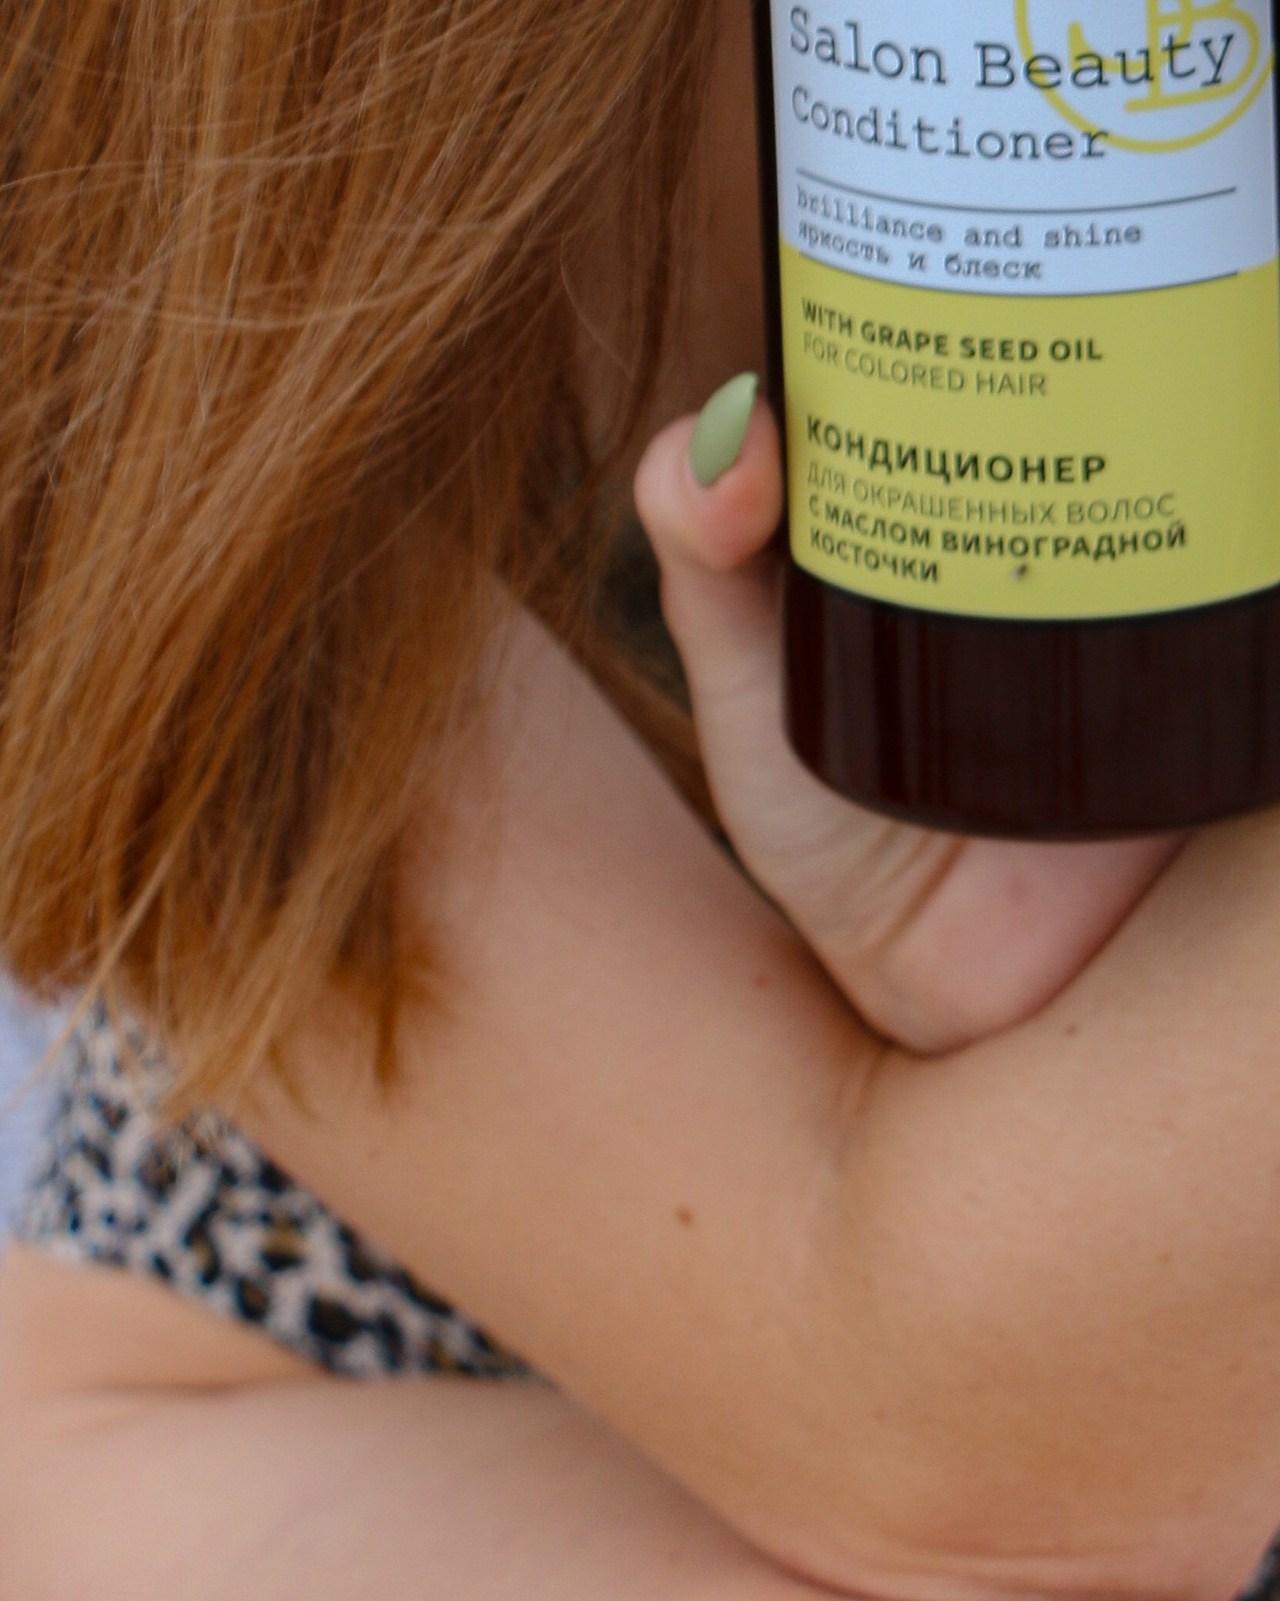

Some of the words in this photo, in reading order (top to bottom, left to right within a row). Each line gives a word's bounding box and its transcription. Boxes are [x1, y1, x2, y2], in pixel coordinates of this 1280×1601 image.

[790, 7, 946, 85] Salon
[974, 33, 1234, 88] Beauty
[791, 85, 1107, 159] Conditioner
[799, 220, 890, 265] яркость
[908, 252, 927, 271] и
[945, 253, 1043, 280] блеск
[964, 226, 1023, 248] and
[1044, 224, 1142, 248] shine
[802, 299, 853, 337] WITH
[860, 320, 949, 355] GRAPE
[959, 336, 1038, 361] SEED
[1048, 338, 1103, 362] OIL
[803, 331, 838, 367] FOR
[844, 349, 965, 392] COLORED
[975, 371, 1047, 396] HAIR
[806, 413, 1107, 485] КОНДИЦИОНЕР
[806, 462, 846, 498] ДЛЯ
[852, 478, 1057, 526] ОКРАШЕННЫХ
[1066, 492, 1176, 526] ВОЛОС
[809, 493, 821, 518] С
[824, 503, 931, 549] МАСЛОМ
[941, 519, 1188, 563] ВИНОГРАДНОЙ
[809, 525, 939, 585] КОСТОЧКИ
